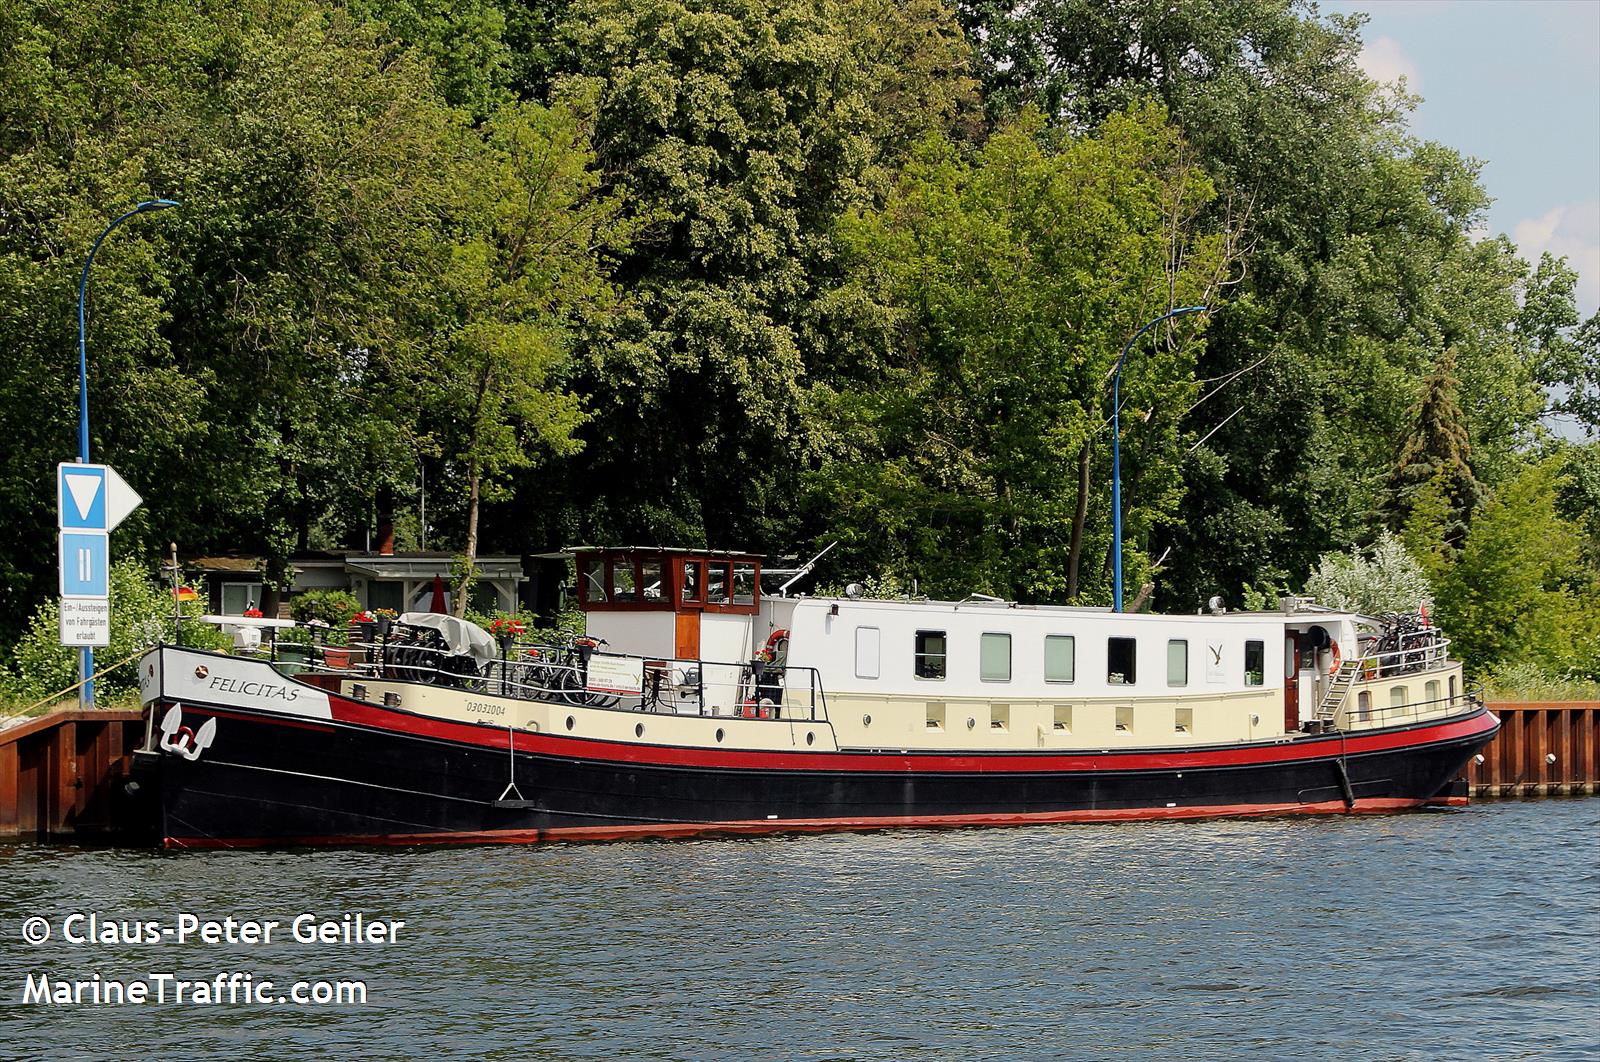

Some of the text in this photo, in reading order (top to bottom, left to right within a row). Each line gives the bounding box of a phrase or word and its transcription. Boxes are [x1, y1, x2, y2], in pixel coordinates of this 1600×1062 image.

[65, 616, 107, 628] von Fahrgästen
[76, 631, 96, 640] erlaubt
[209, 676, 300, 702] FELICITAS
